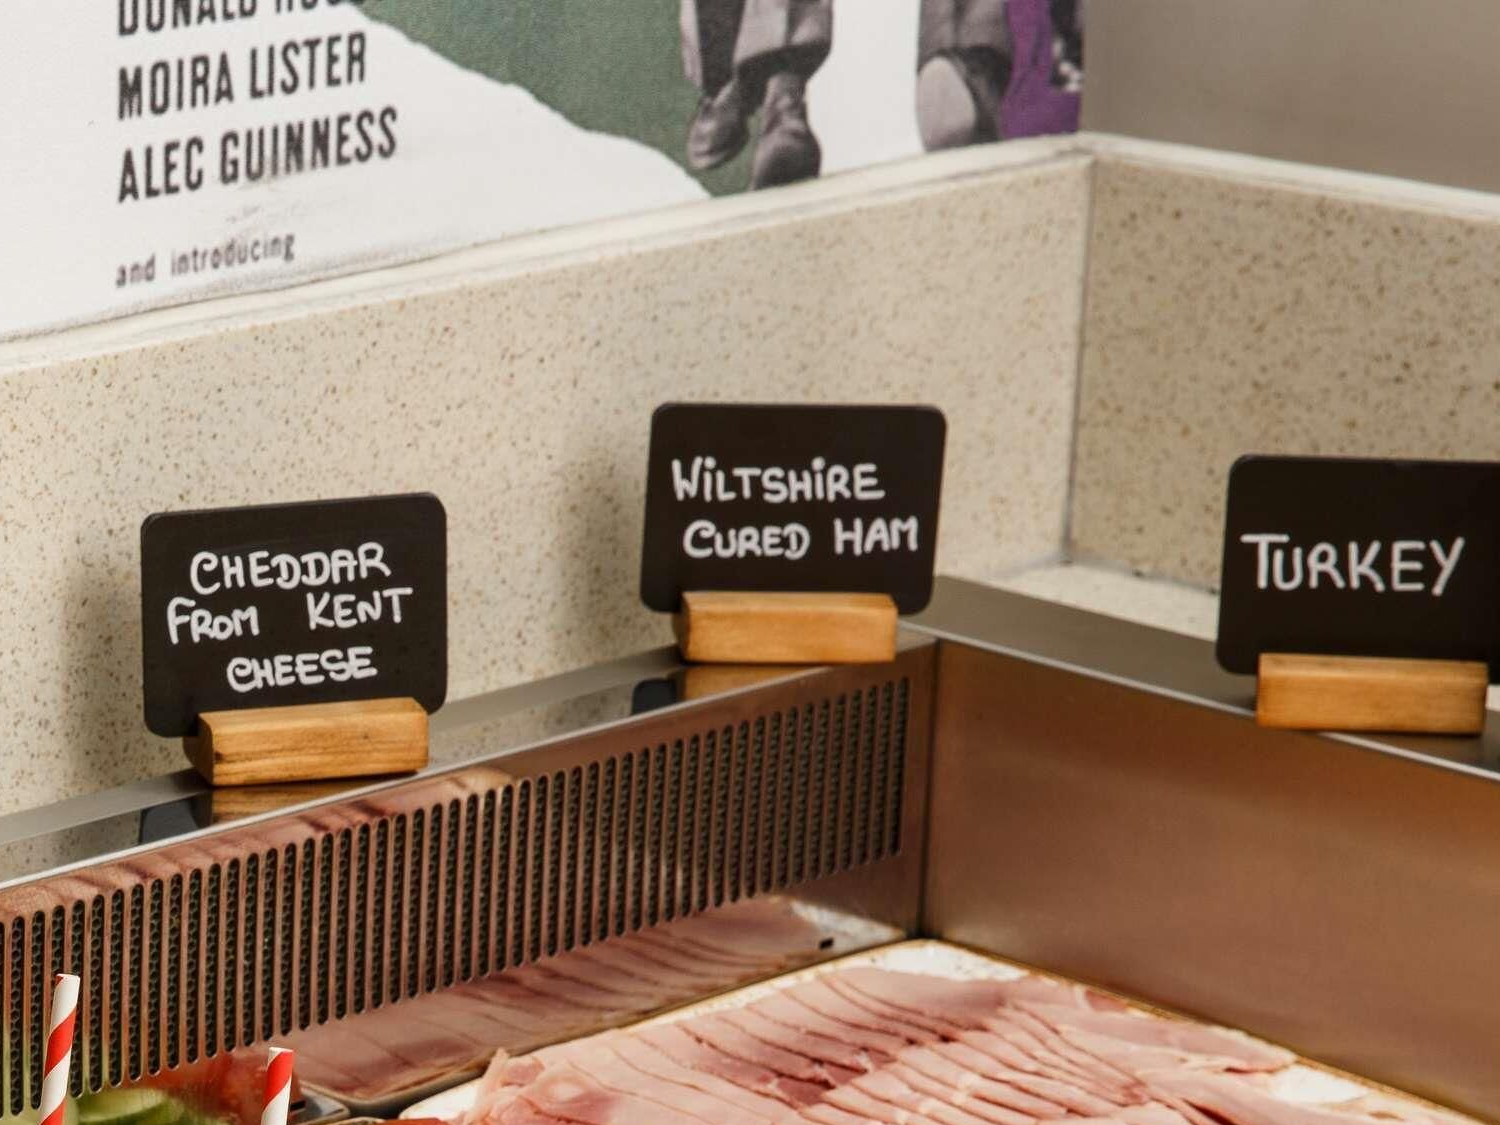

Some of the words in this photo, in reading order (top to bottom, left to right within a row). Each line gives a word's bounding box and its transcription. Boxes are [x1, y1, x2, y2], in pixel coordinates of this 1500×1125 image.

[118, 52, 234, 120] MOIRA
[249, 32, 367, 99] LISTER
[117, 136, 204, 203] ALEC
[219, 106, 398, 184] GUINNESS
[115, 255, 156, 288] and
[171, 234, 296, 276] introducing
[683, 519, 810, 560] CURED
[833, 516, 918, 555] HAM
[1240, 533, 1465, 596] TURKEY
[189, 542, 391, 595] CHEDDAR
[166, 597, 260, 644] FROM
[307, 587, 413, 630] KENT
[226, 646, 378, 693] CHEESE
